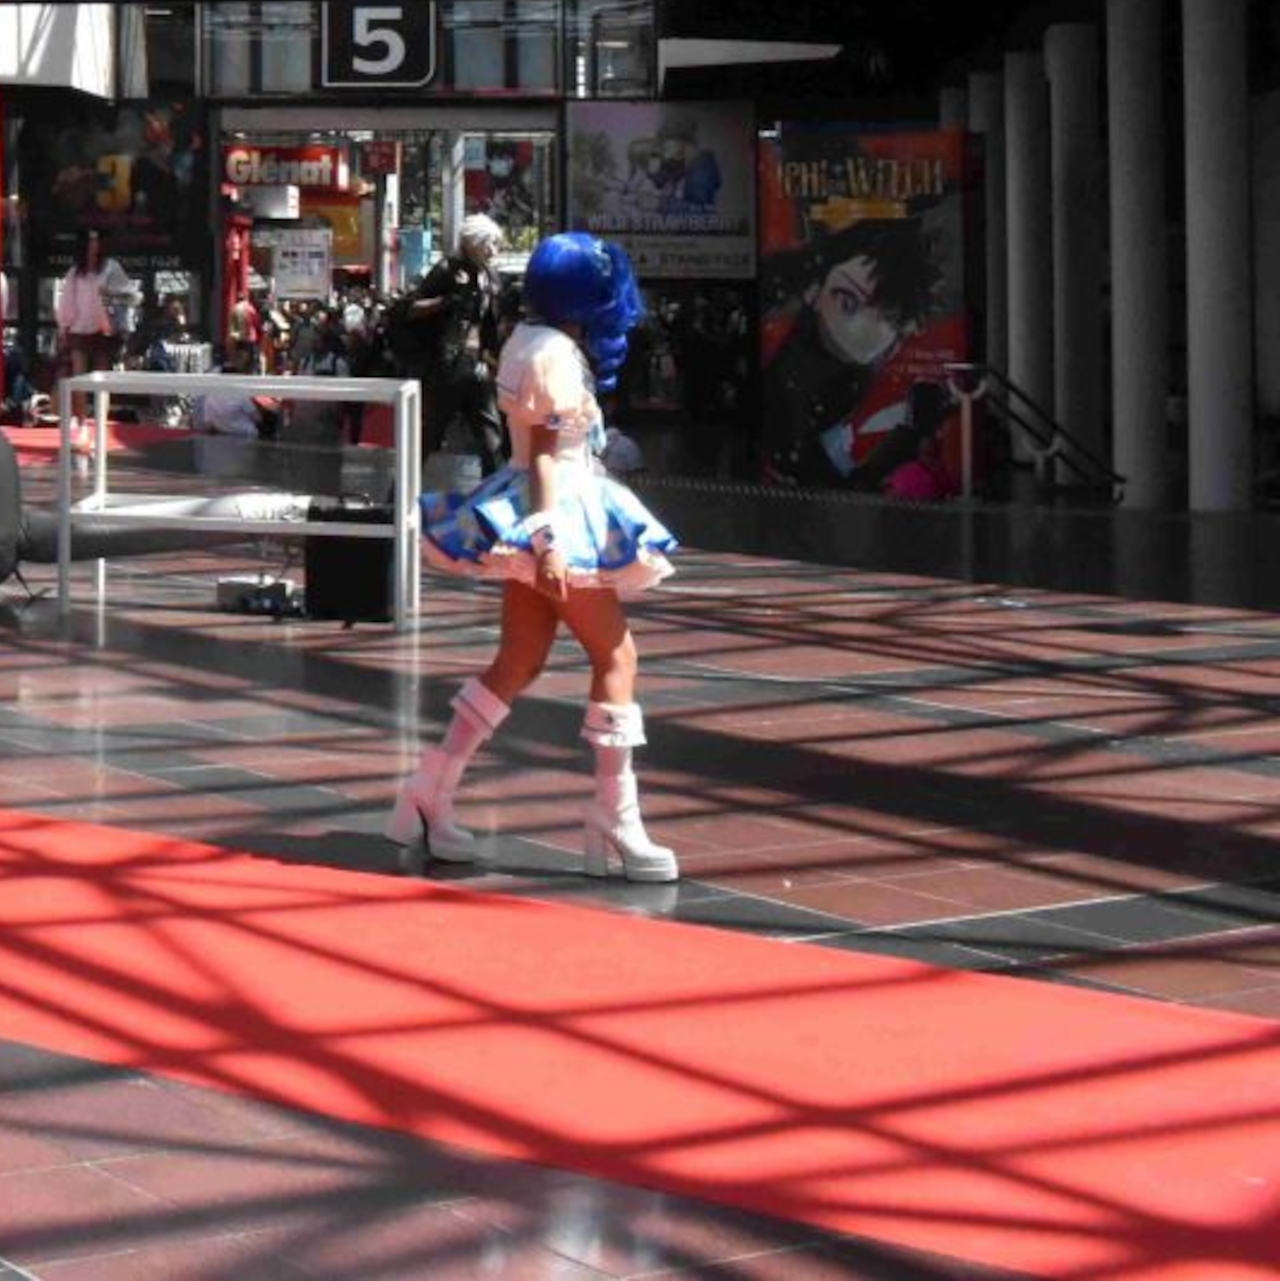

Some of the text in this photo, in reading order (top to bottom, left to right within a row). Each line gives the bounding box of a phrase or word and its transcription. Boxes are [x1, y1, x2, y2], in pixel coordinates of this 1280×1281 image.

[352, 6, 406, 75] 5
[225, 149, 332, 184] Glénat
[587, 212, 628, 231] WILD
